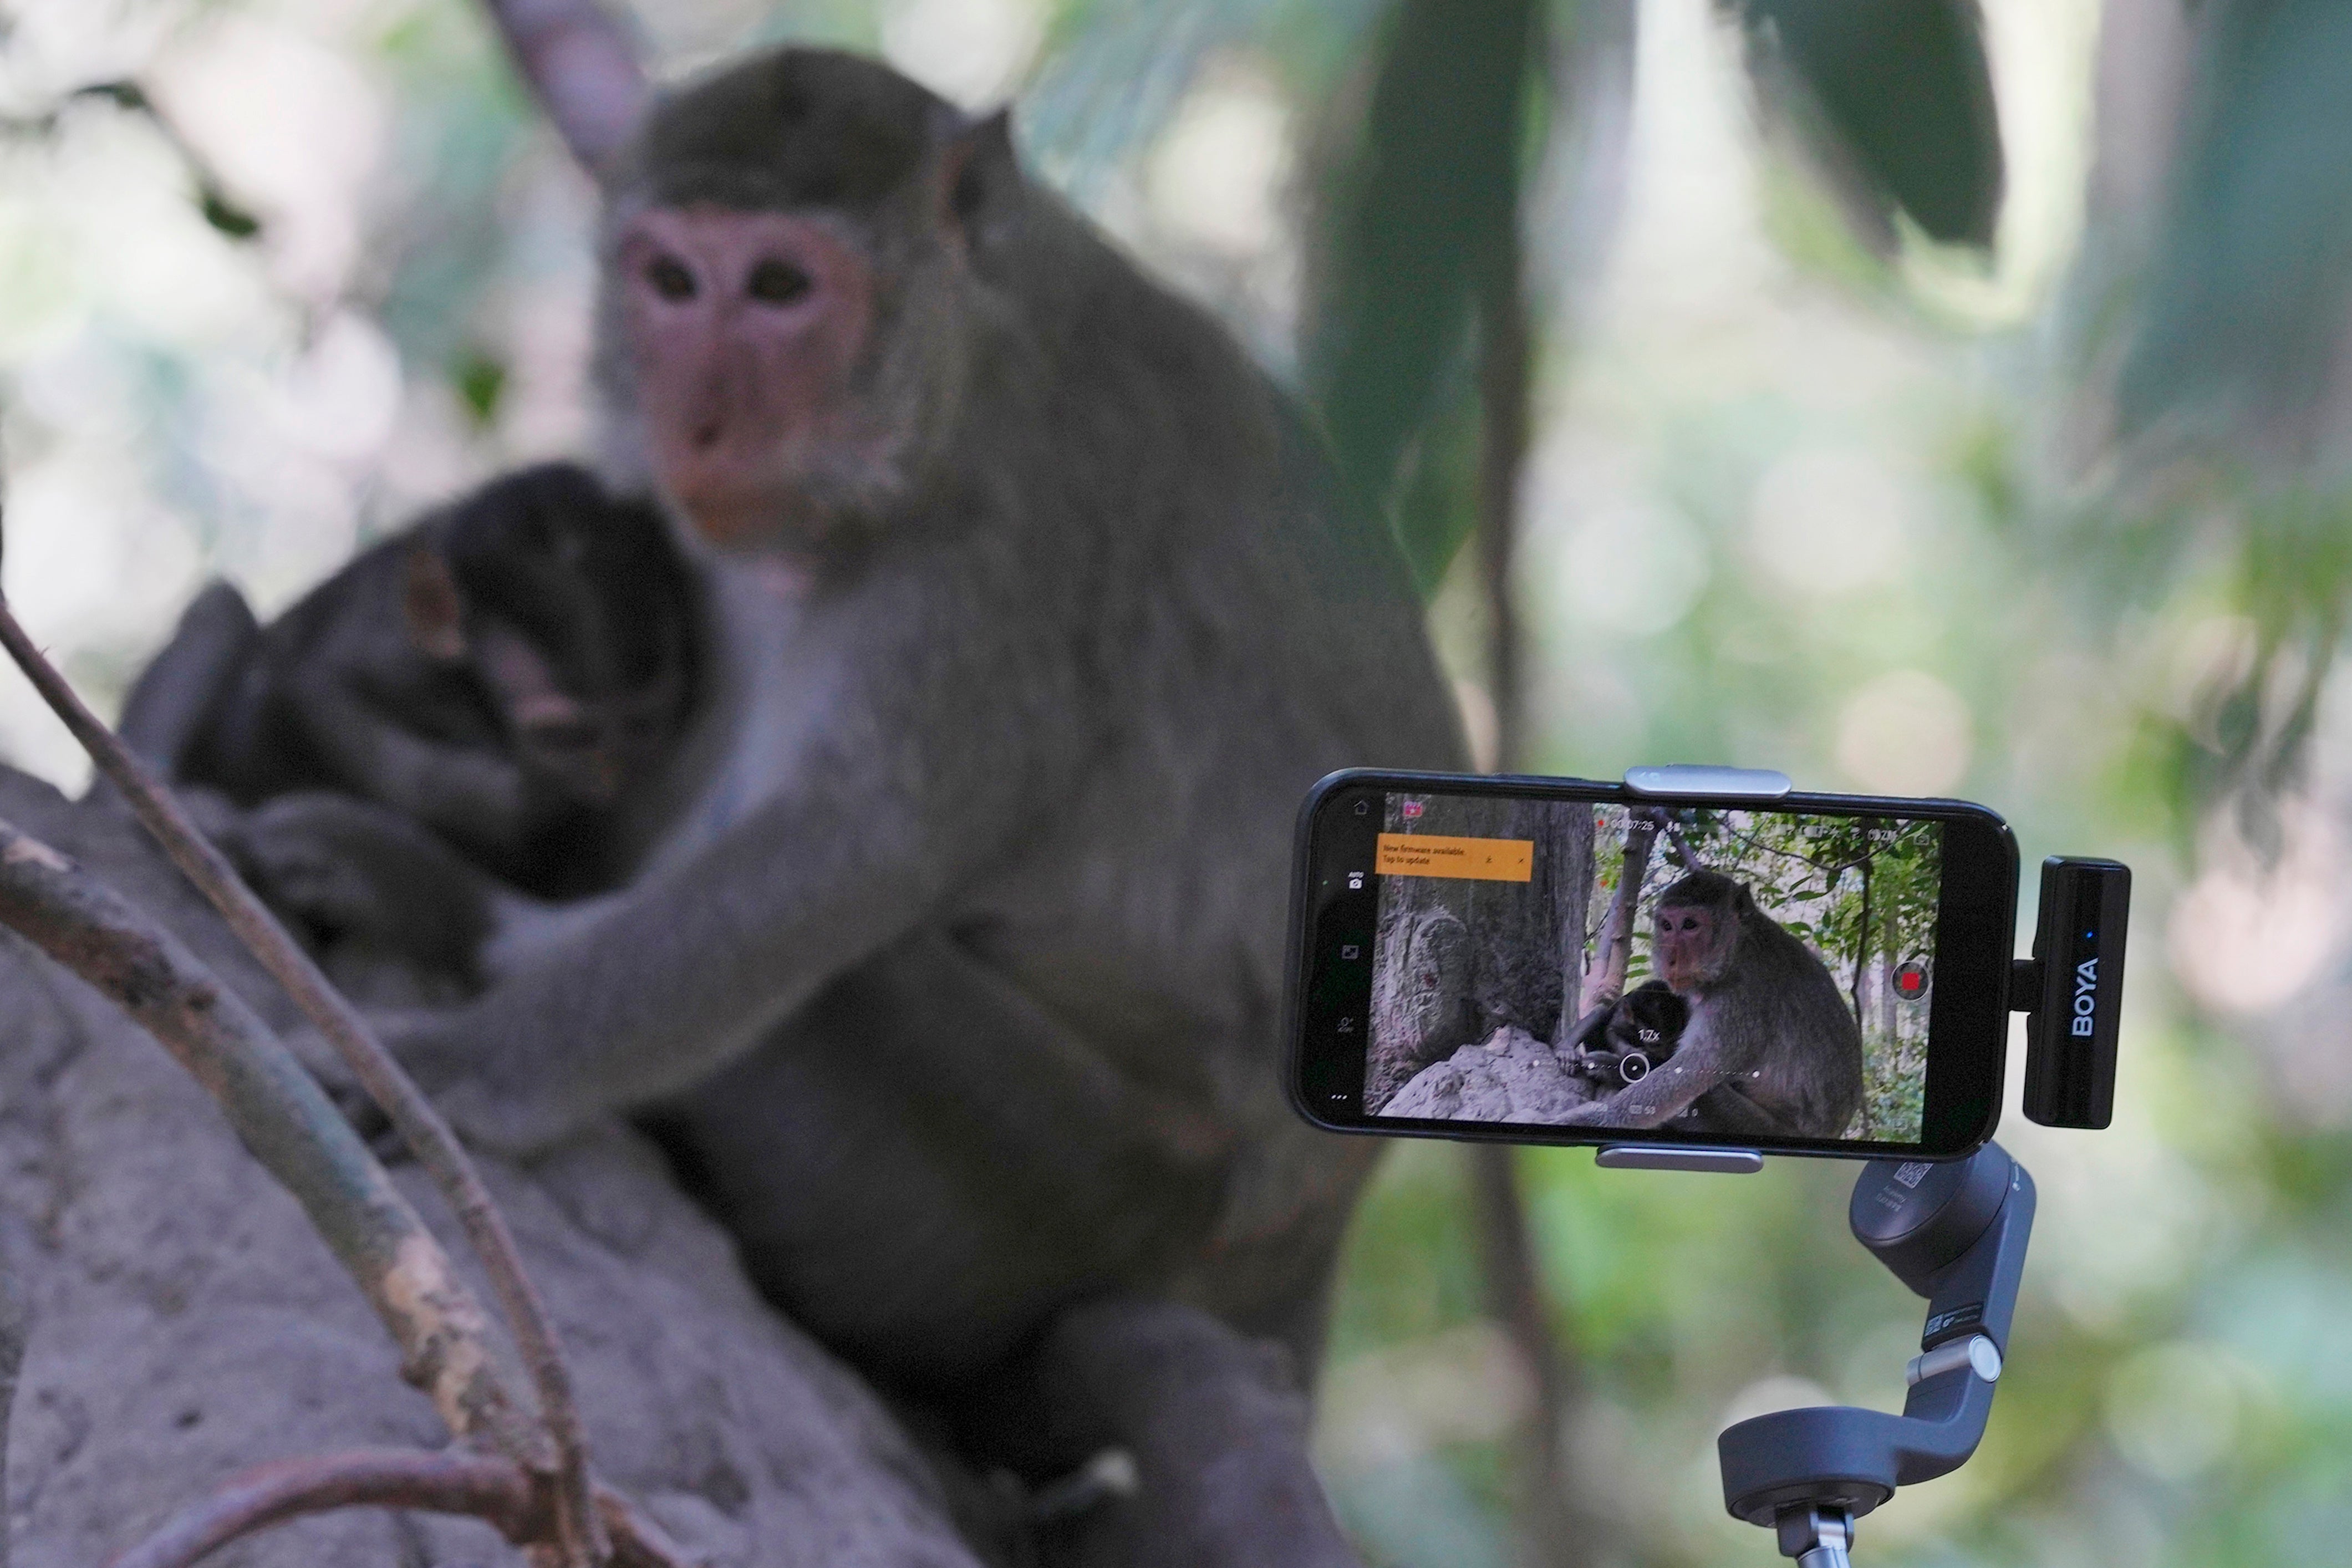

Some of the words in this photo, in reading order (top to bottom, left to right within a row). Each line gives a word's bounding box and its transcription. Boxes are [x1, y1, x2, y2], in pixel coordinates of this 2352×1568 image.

[1610, 819, 1654, 831] 0007:25
[1383, 854, 1395, 864] Tap
[1406, 857, 1430, 865] update
[2072, 958, 2099, 1036] BOYA
